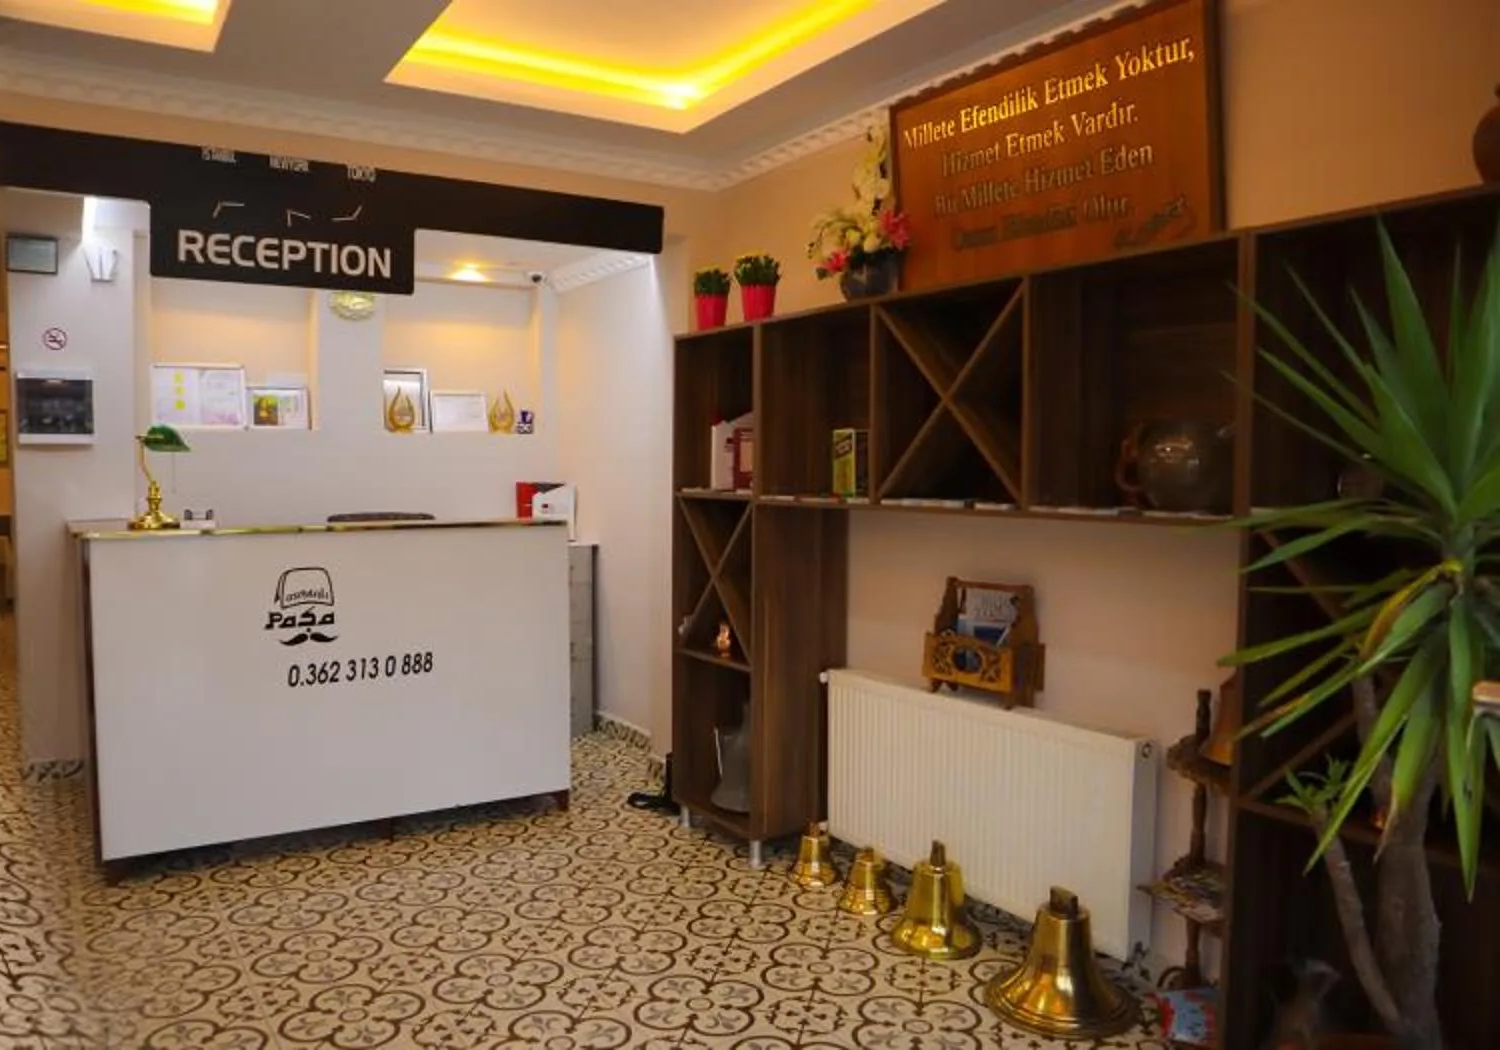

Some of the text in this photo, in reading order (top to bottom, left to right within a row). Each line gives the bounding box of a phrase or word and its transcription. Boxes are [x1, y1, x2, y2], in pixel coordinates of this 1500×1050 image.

[903, 37, 1196, 149] Millete Efendilik Etmek Yoktur,
[942, 101, 1139, 178] Hizmet Etmek Vardır.
[1023, 160, 1095, 194] Hizmet
[1100, 143, 1154, 176] Eden
[177, 229, 392, 279] RECEPTION
[287, 651, 434, 688] 0.362 313 0 888
